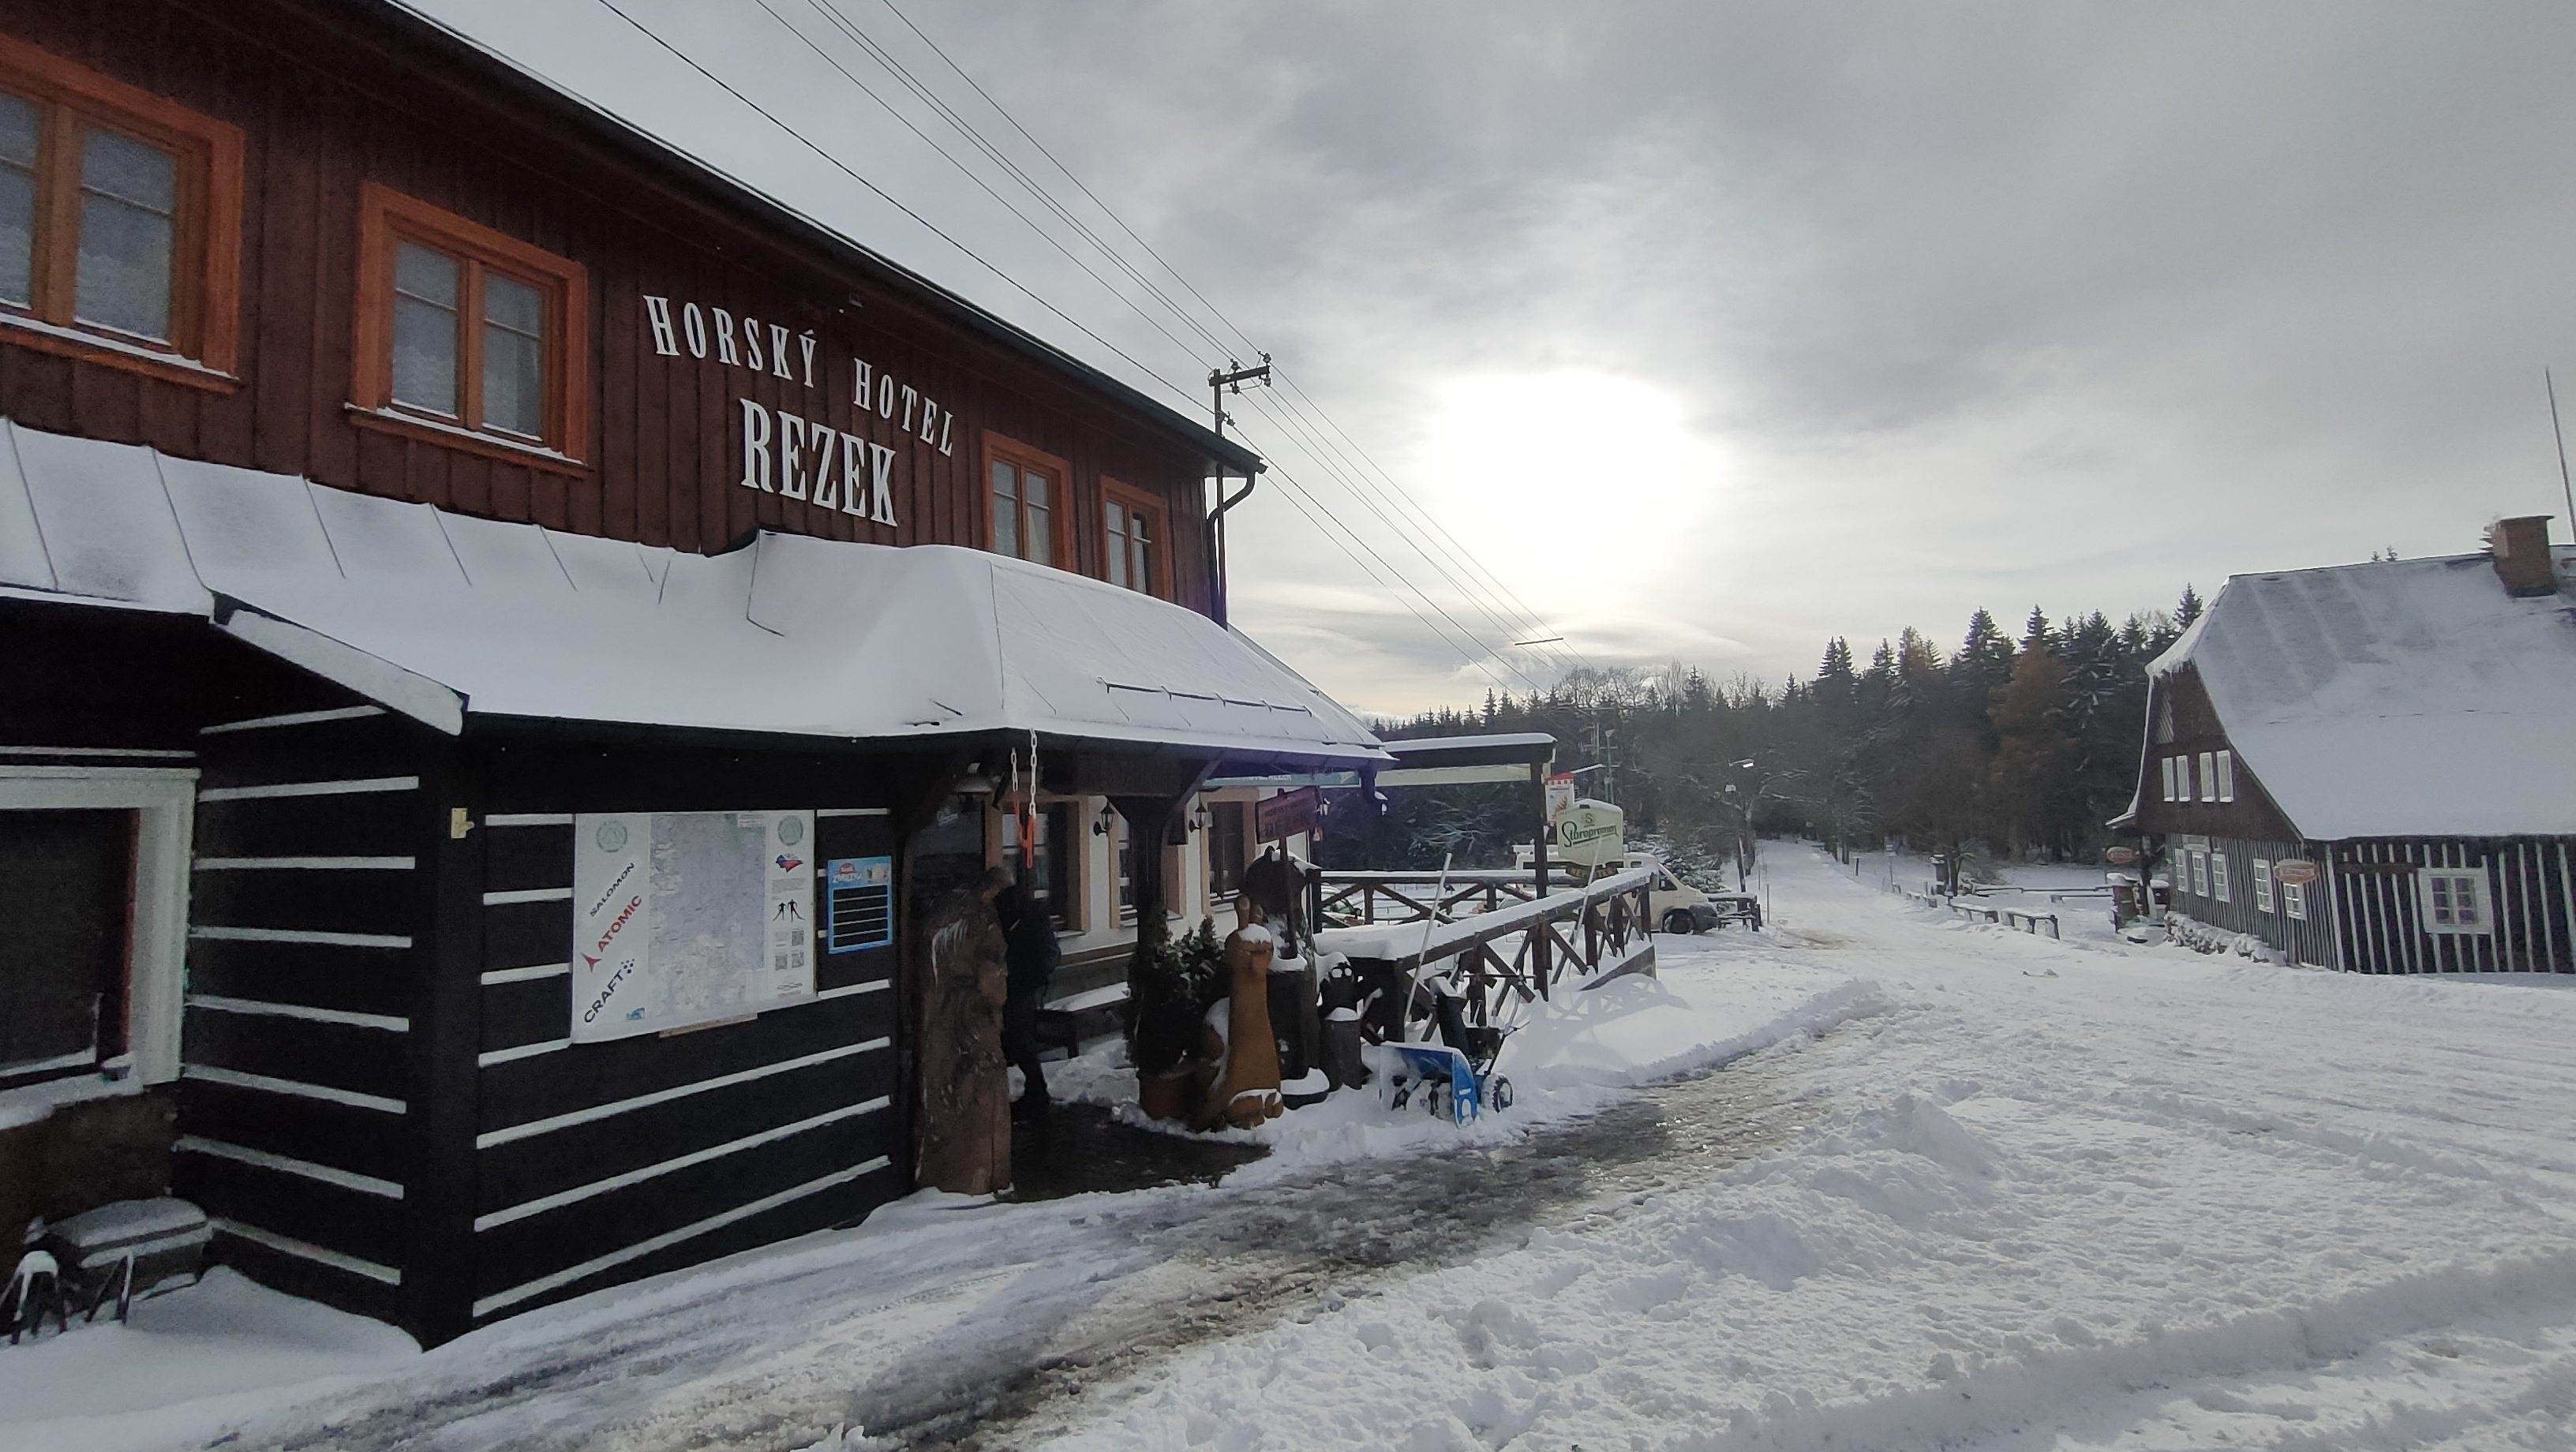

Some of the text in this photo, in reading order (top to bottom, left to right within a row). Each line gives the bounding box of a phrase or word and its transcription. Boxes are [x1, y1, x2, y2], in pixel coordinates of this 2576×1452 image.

[642, 294, 953, 457] HORSKÝ HOTEL
[739, 398, 898, 527] REZEK
[1562, 821, 1619, 848] Staropramen
[590, 863, 635, 917] SALOMON
[598, 895, 642, 952] ATOMIC
[584, 969, 623, 1022] CRAFT
